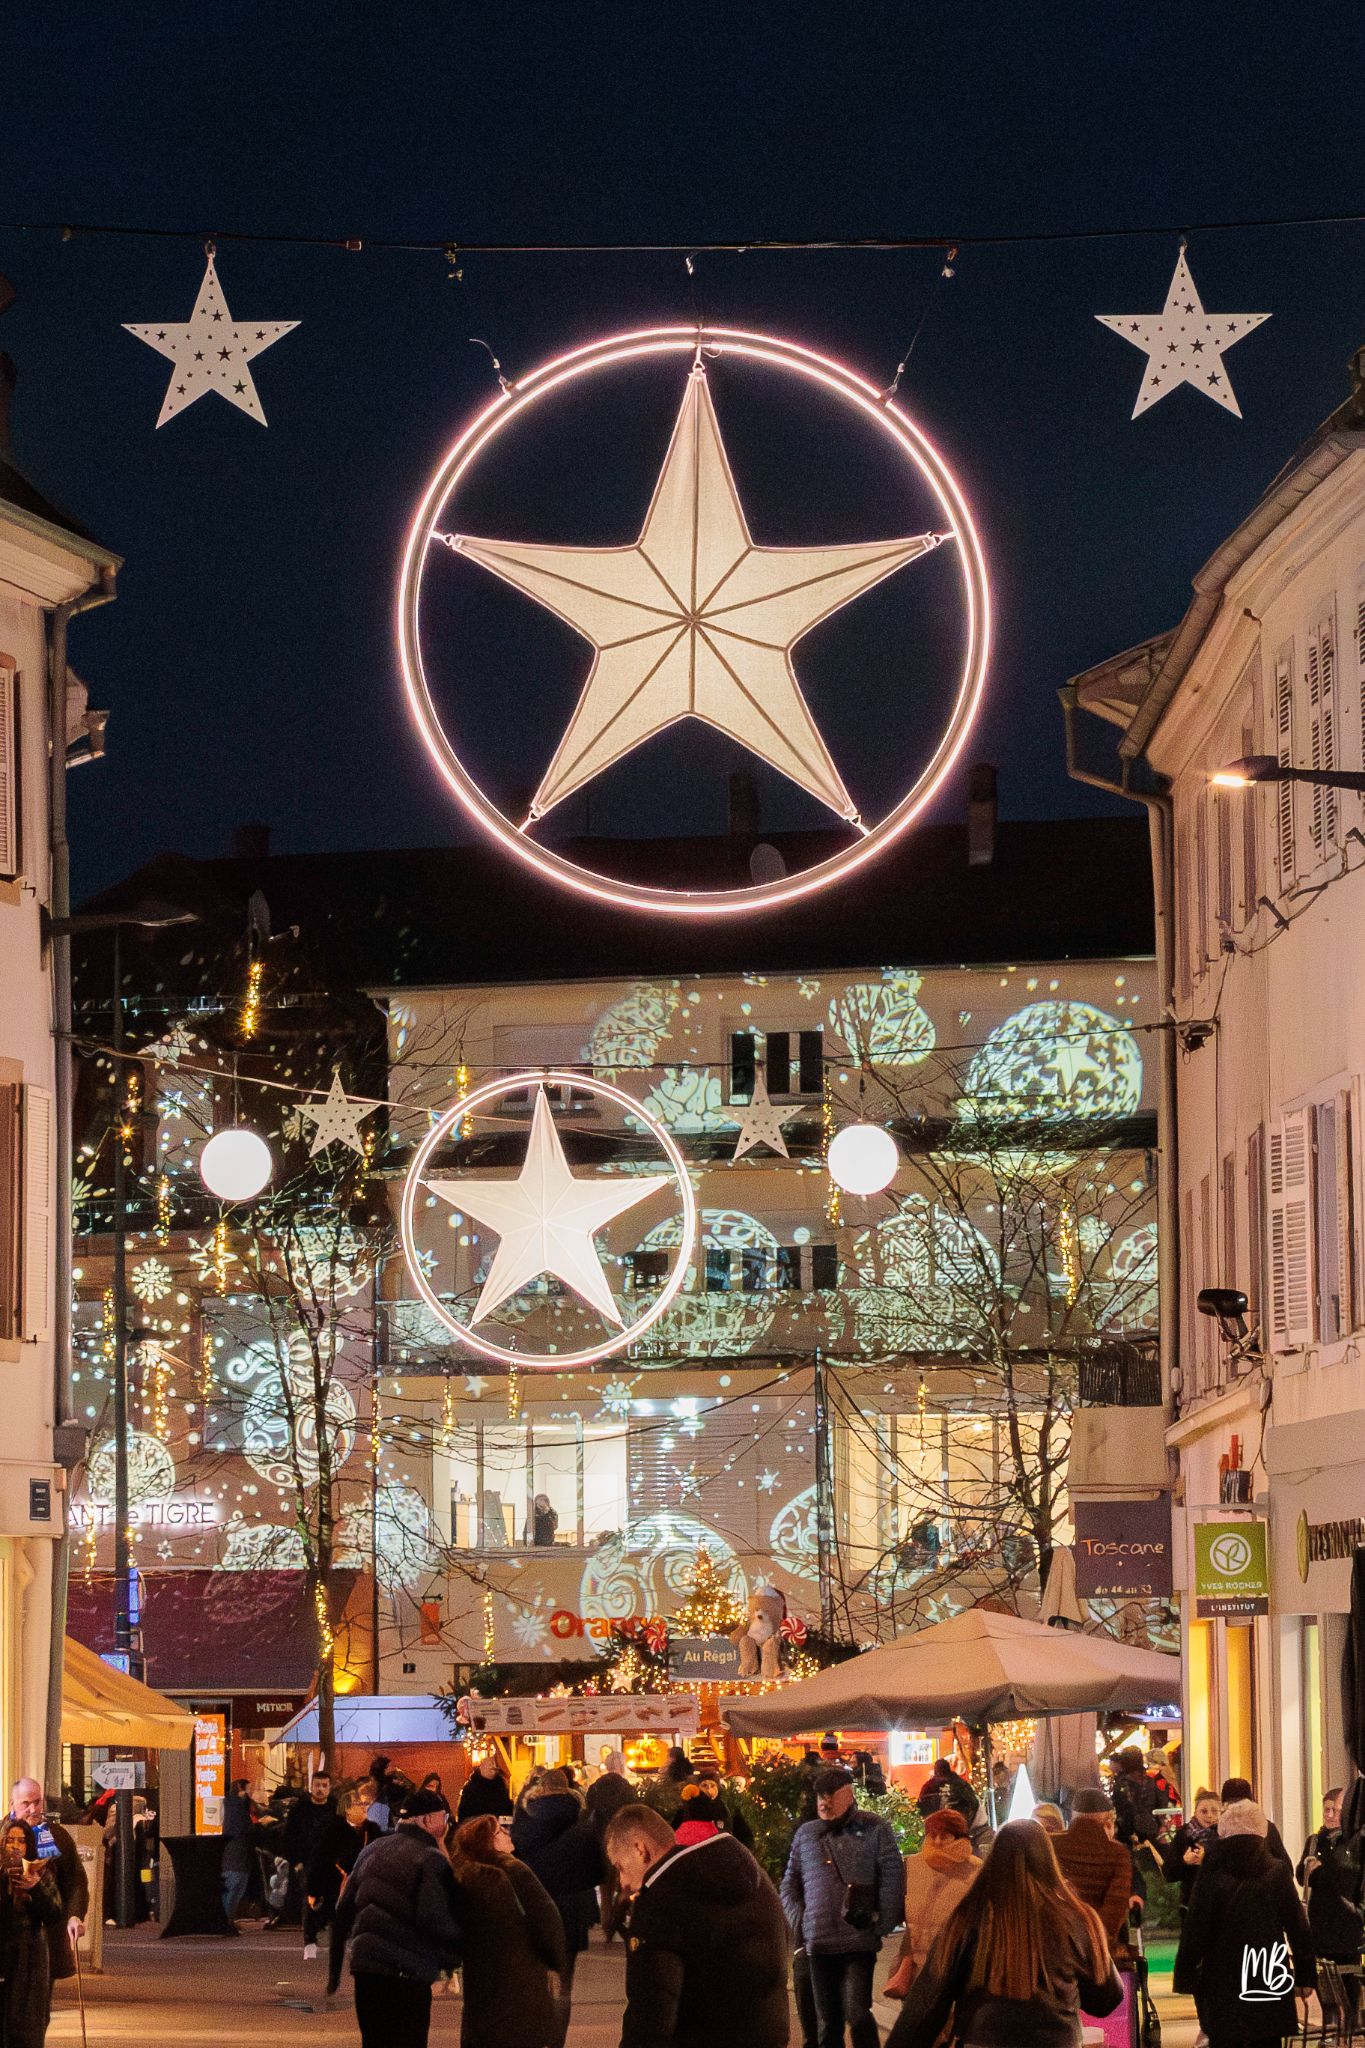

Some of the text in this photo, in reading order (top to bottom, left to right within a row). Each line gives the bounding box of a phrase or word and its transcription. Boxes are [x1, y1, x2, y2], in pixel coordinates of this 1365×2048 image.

[146, 1502, 215, 1524] TIGRE
[1080, 1538, 1164, 1556] Toscane
[1211, 1603, 1255, 1611] L'INSTITUT
[683, 1650, 737, 1664] Au Régal
